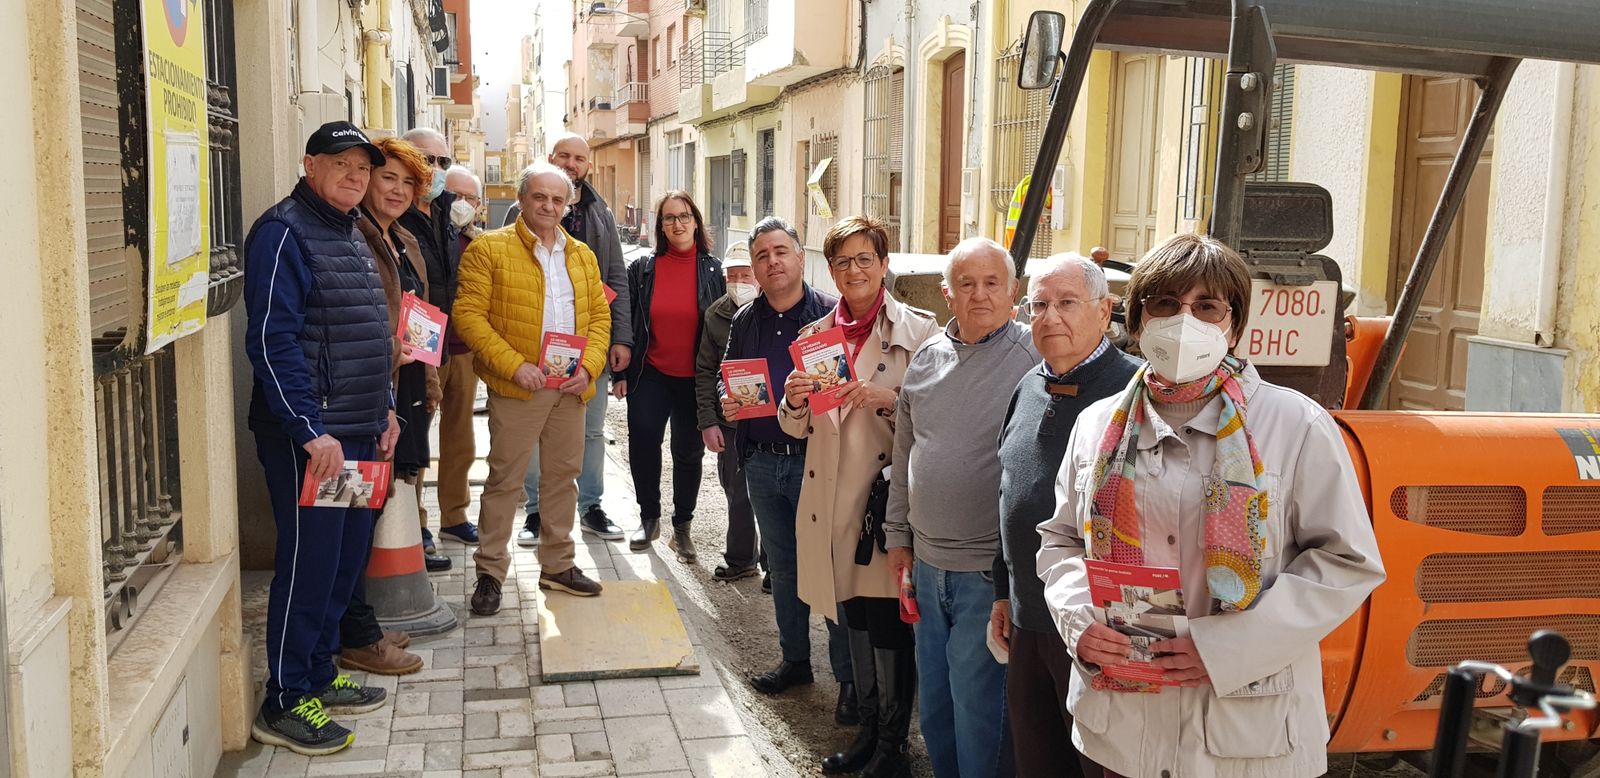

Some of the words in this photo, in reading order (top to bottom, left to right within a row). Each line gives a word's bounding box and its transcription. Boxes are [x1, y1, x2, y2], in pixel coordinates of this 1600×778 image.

[148, 49, 205, 101] ESTACIONAMIENTO
[163, 87, 197, 123] PROHIBIDO
[332, 129, 357, 137] Calvin
[1260, 289, 1320, 316] 7080
[802, 343, 828, 355] CONSEGUIDO
[807, 341, 821, 350] HEMOS
[1249, 329, 1299, 356] BHC
[1575, 455, 1600, 480] N
